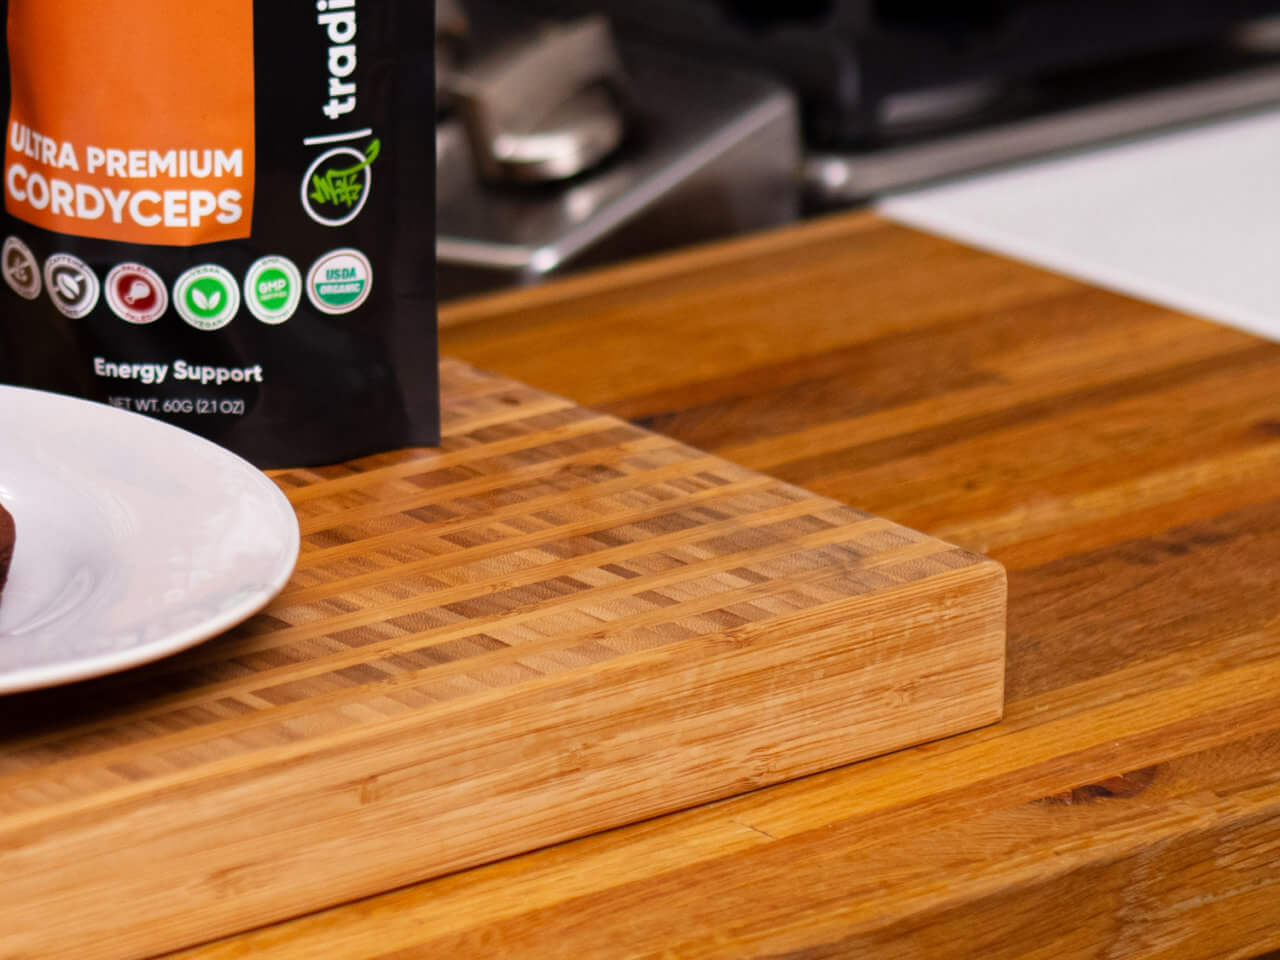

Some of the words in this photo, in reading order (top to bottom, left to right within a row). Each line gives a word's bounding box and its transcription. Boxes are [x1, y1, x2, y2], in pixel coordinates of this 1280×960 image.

[11, 122, 79, 171] ULTRA
[87, 147, 242, 178] PREMIUM
[7, 164, 242, 227] CORDYCEPS
[326, 267, 357, 280] USDA
[258, 279, 287, 294] GMP
[319, 283, 361, 295] ORGANIC
[93, 357, 168, 384] Energy
[173, 360, 264, 385] Support
[108, 396, 132, 409] NET
[135, 399, 160, 412] WT.
[162, 400, 194, 414] 60G
[196, 399, 218, 415] (2.1
[219, 400, 246, 415] OZ)
